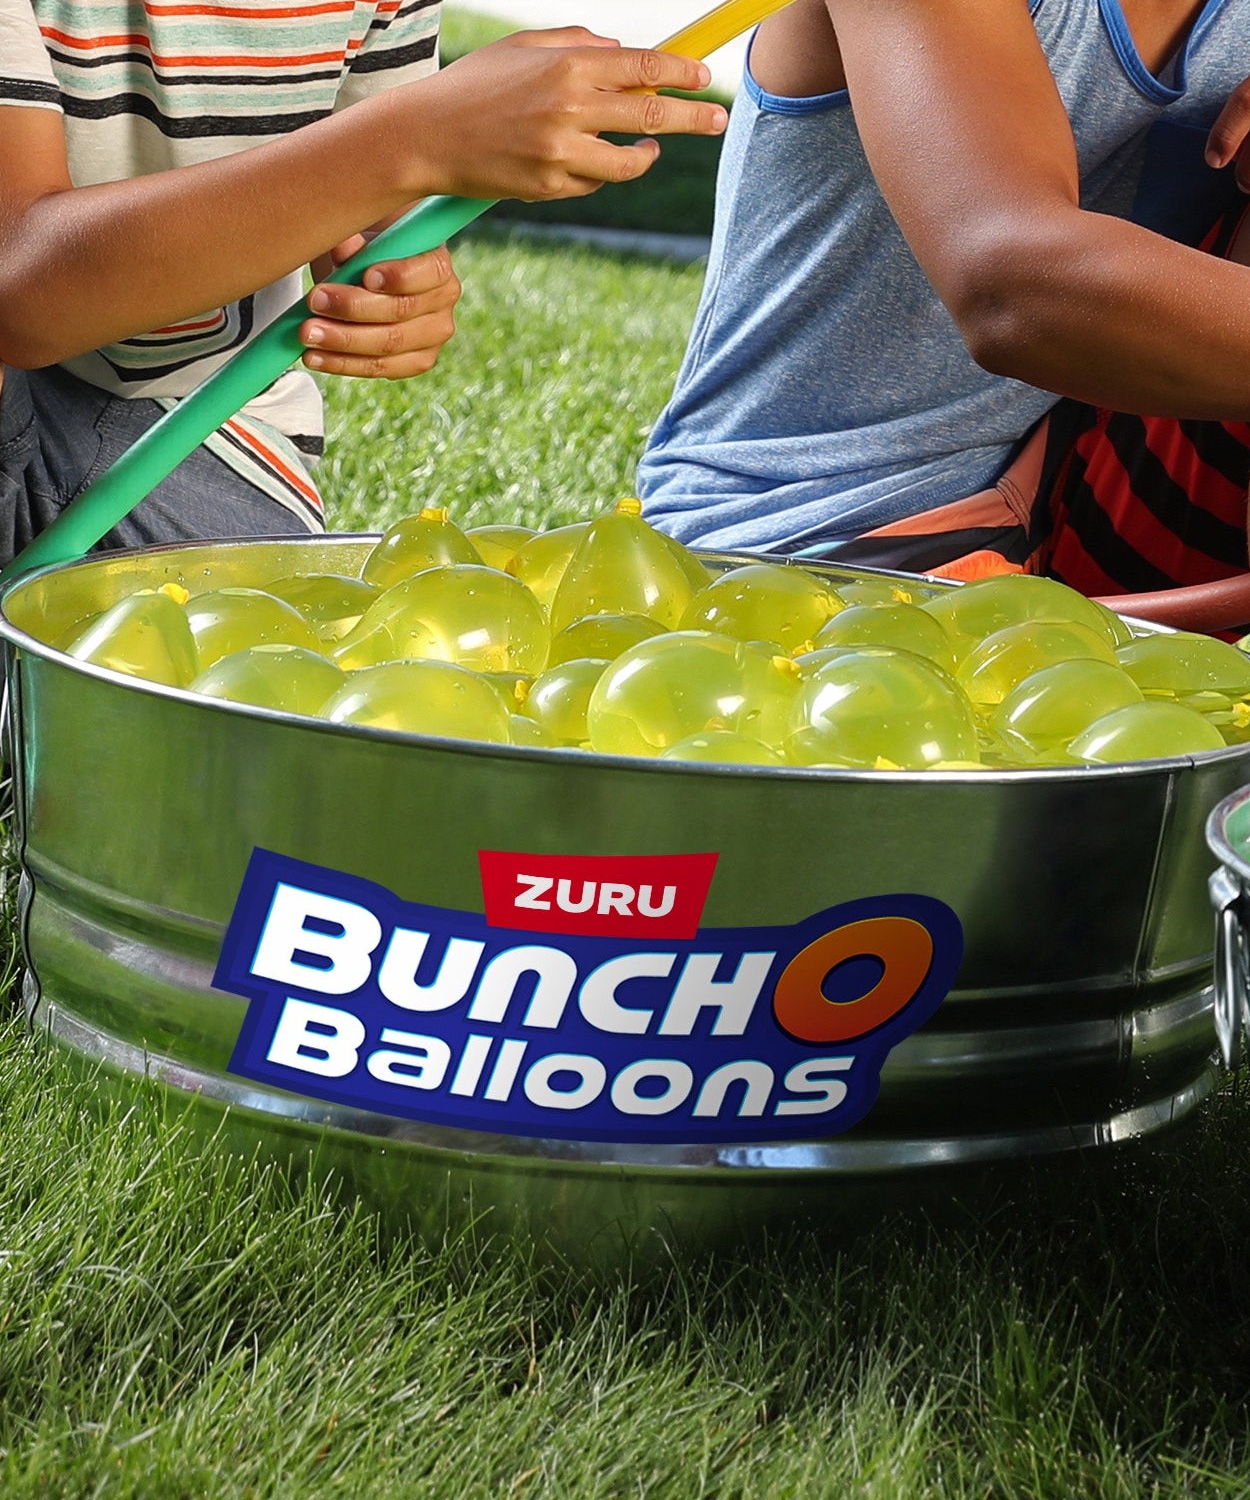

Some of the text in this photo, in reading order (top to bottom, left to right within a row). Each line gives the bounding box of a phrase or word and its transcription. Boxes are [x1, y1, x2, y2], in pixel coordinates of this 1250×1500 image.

[514, 873, 677, 918] ZURU
[250, 882, 933, 1042] BUNCH O
[265, 997, 855, 1118] Balloons
